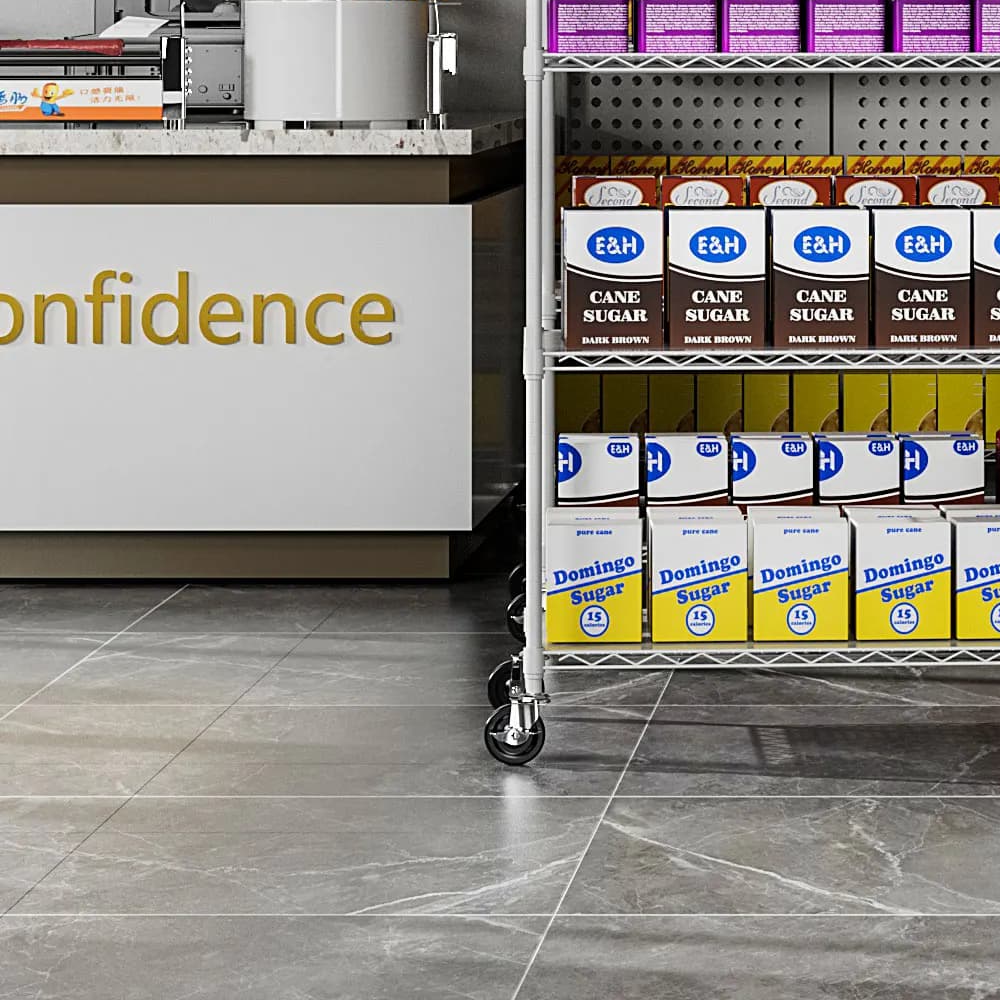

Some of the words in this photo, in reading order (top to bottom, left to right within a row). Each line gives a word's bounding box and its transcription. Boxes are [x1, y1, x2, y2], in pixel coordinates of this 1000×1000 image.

[588, 185, 635, 206] Second
[596, 236, 636, 254] E&H
[698, 236, 739, 254] E&H
[802, 236, 843, 253] E&H
[904, 235, 944, 253] E&H
[590, 291, 640, 303] CANE
[692, 290, 742, 303] CANE
[797, 290, 846, 302] CANE
[898, 290, 948, 302] CANE
[584, 309, 648, 322] SUGAR
[686, 309, 750, 321] SUGAR
[790, 308, 854, 321] SUGAR
[892, 308, 955, 320] SUGAR
[612, 336, 649, 344] BROWN
[818, 335, 856, 344] BROWN
[611, 444, 629, 454] E&H
[700, 444, 719, 454] E&H
[785, 444, 804, 453] E&H
[871, 443, 890, 453] E&H
[956, 442, 975, 452] E&H
[682, 528, 699, 536] pure
[886, 526, 903, 534] pure
[554, 556, 635, 586] Domingo
[660, 555, 741, 585] Domingo
[761, 554, 842, 584] Domingo
[864, 553, 944, 583] Domingo
[571, 581, 624, 605] Sugar
[677, 580, 730, 604] Sugar
[778, 579, 831, 603] Sugar
[881, 578, 934, 602] Sugar
[587, 611, 602, 622] 15
[693, 610, 707, 621] 15
[794, 609, 808, 620] 15
[897, 608, 912, 619] 15
